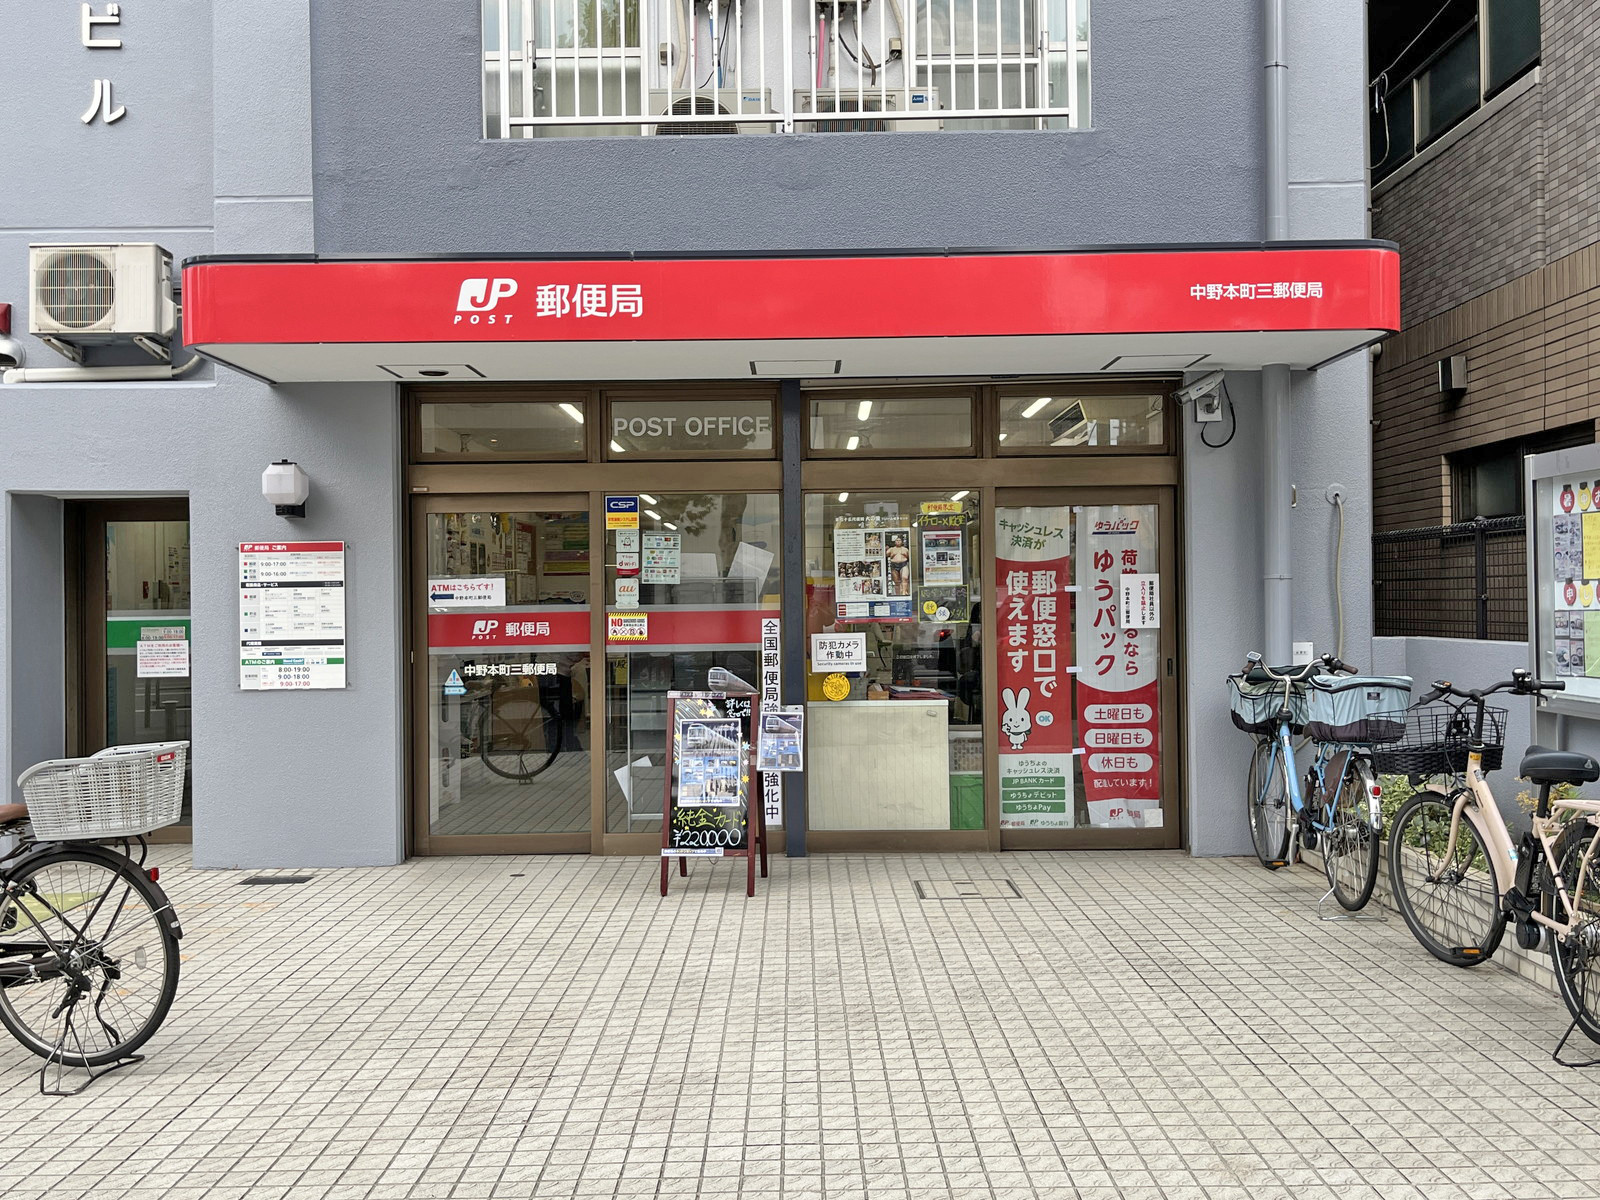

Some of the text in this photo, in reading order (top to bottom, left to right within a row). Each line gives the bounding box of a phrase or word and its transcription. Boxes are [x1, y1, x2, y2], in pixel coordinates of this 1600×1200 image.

[80, 2, 126, 124] ビル
[456, 278, 518, 312] JP
[1190, 281, 1323, 301] 中野本町三郵便局
[535, 283, 643, 318] 郵便局
[453, 314, 513, 325] POST
[613, 416, 770, 437] POST OFFICE
[610, 501, 635, 509] CSP
[998, 518, 1064, 539] キャッシュレス
[1095, 519, 1140, 531] ゆうパック
[1010, 534, 1046, 551] 決済が
[619, 585, 637, 593] au
[1093, 549, 1117, 676] ゆうパック
[611, 618, 623, 627] NO
[1005, 570, 1029, 673] 使えます
[505, 622, 550, 637] 郵便局
[1031, 570, 1058, 698] 郵便窓口で
[819, 641, 859, 650] 防犯カメラ
[826, 651, 853, 659] 作動中
[464, 663, 557, 676] 中野本町三郵便局
[1038, 715, 1051, 724] OK
[1094, 708, 1145, 720] 土曜日も
[1095, 732, 1145, 745] 日曜日も
[1101, 756, 1139, 769] 休日も
[1006, 767, 1060, 775] キャッシュレス決済
[677, 808, 742, 828] 純金カード
